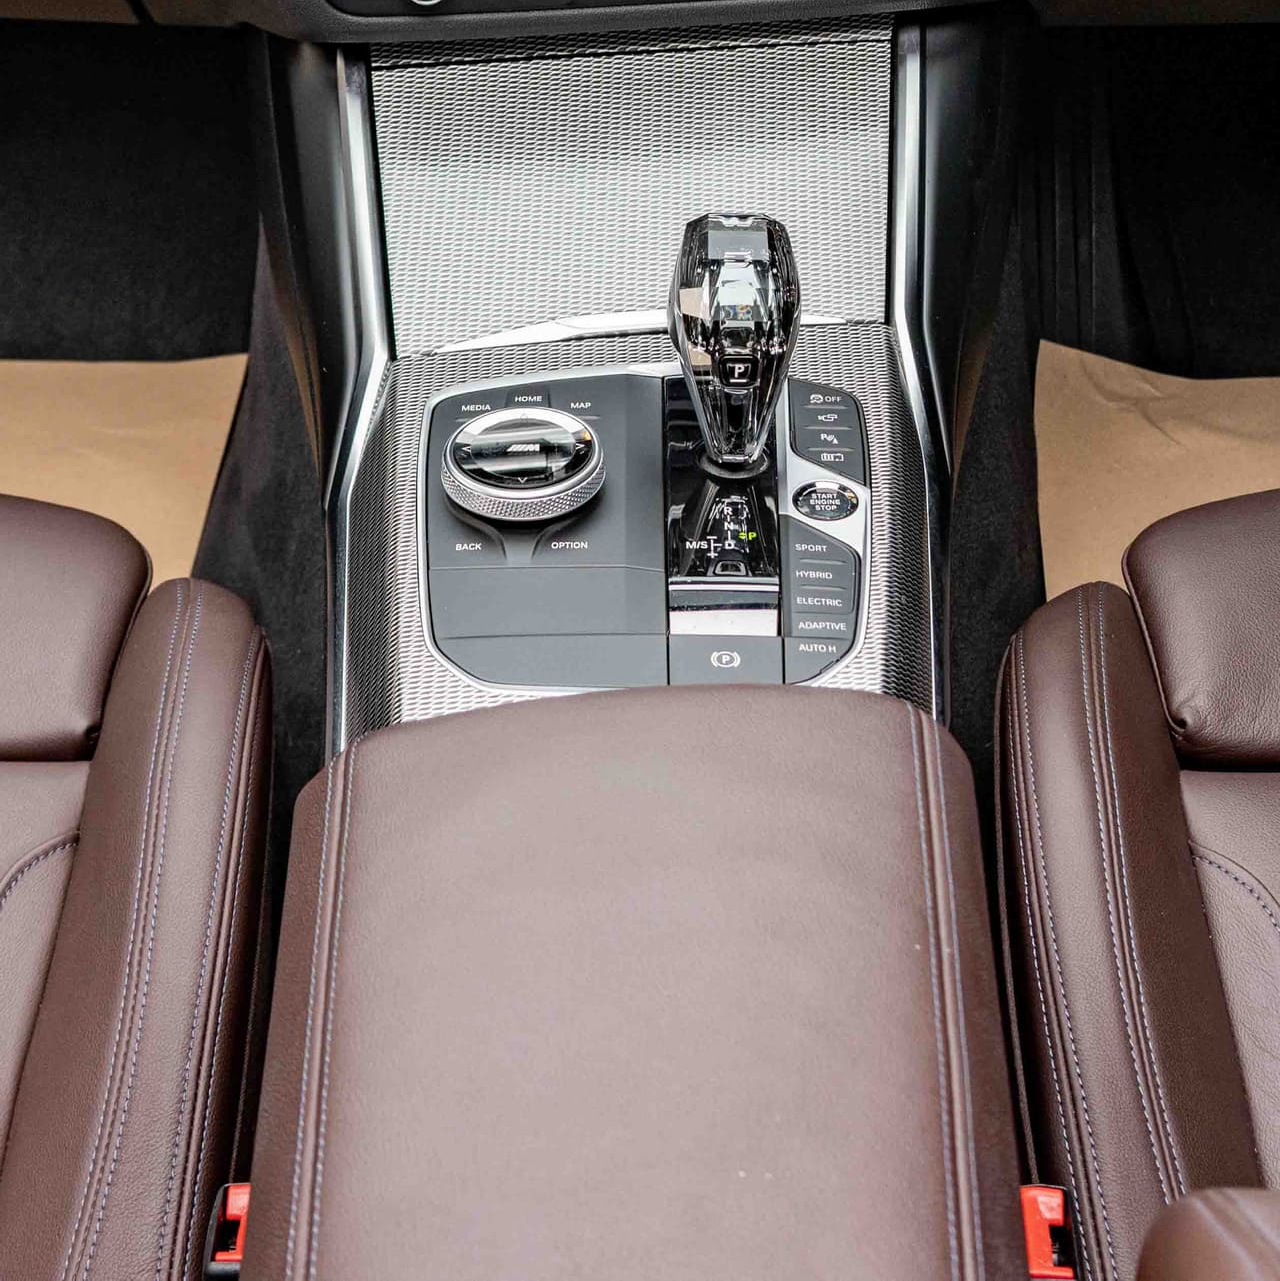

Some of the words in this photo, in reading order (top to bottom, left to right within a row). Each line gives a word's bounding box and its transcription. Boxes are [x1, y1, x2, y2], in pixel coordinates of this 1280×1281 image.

[734, 363, 745, 379] P
[514, 394, 543, 403] HOME
[824, 395, 842, 403] OFF
[460, 403, 492, 412] MEDIA
[570, 401, 592, 409] MAP
[809, 498, 841, 506] ENGINE
[723, 506, 733, 516] R
[815, 504, 838, 512] STOP
[724, 521, 734, 530] N
[748, 531, 758, 541] P
[455, 542, 483, 551] BACK
[550, 541, 589, 550] OPTION
[685, 540, 709, 550] M/S
[725, 540, 735, 550] D
[794, 543, 828, 553] SPORT
[795, 569, 834, 580] HYBRID
[796, 596, 844, 607] ELECTRIC
[798, 620, 848, 631] ADAPTIVE
[799, 643, 827, 653] AUTO
[828, 645, 837, 654] H
